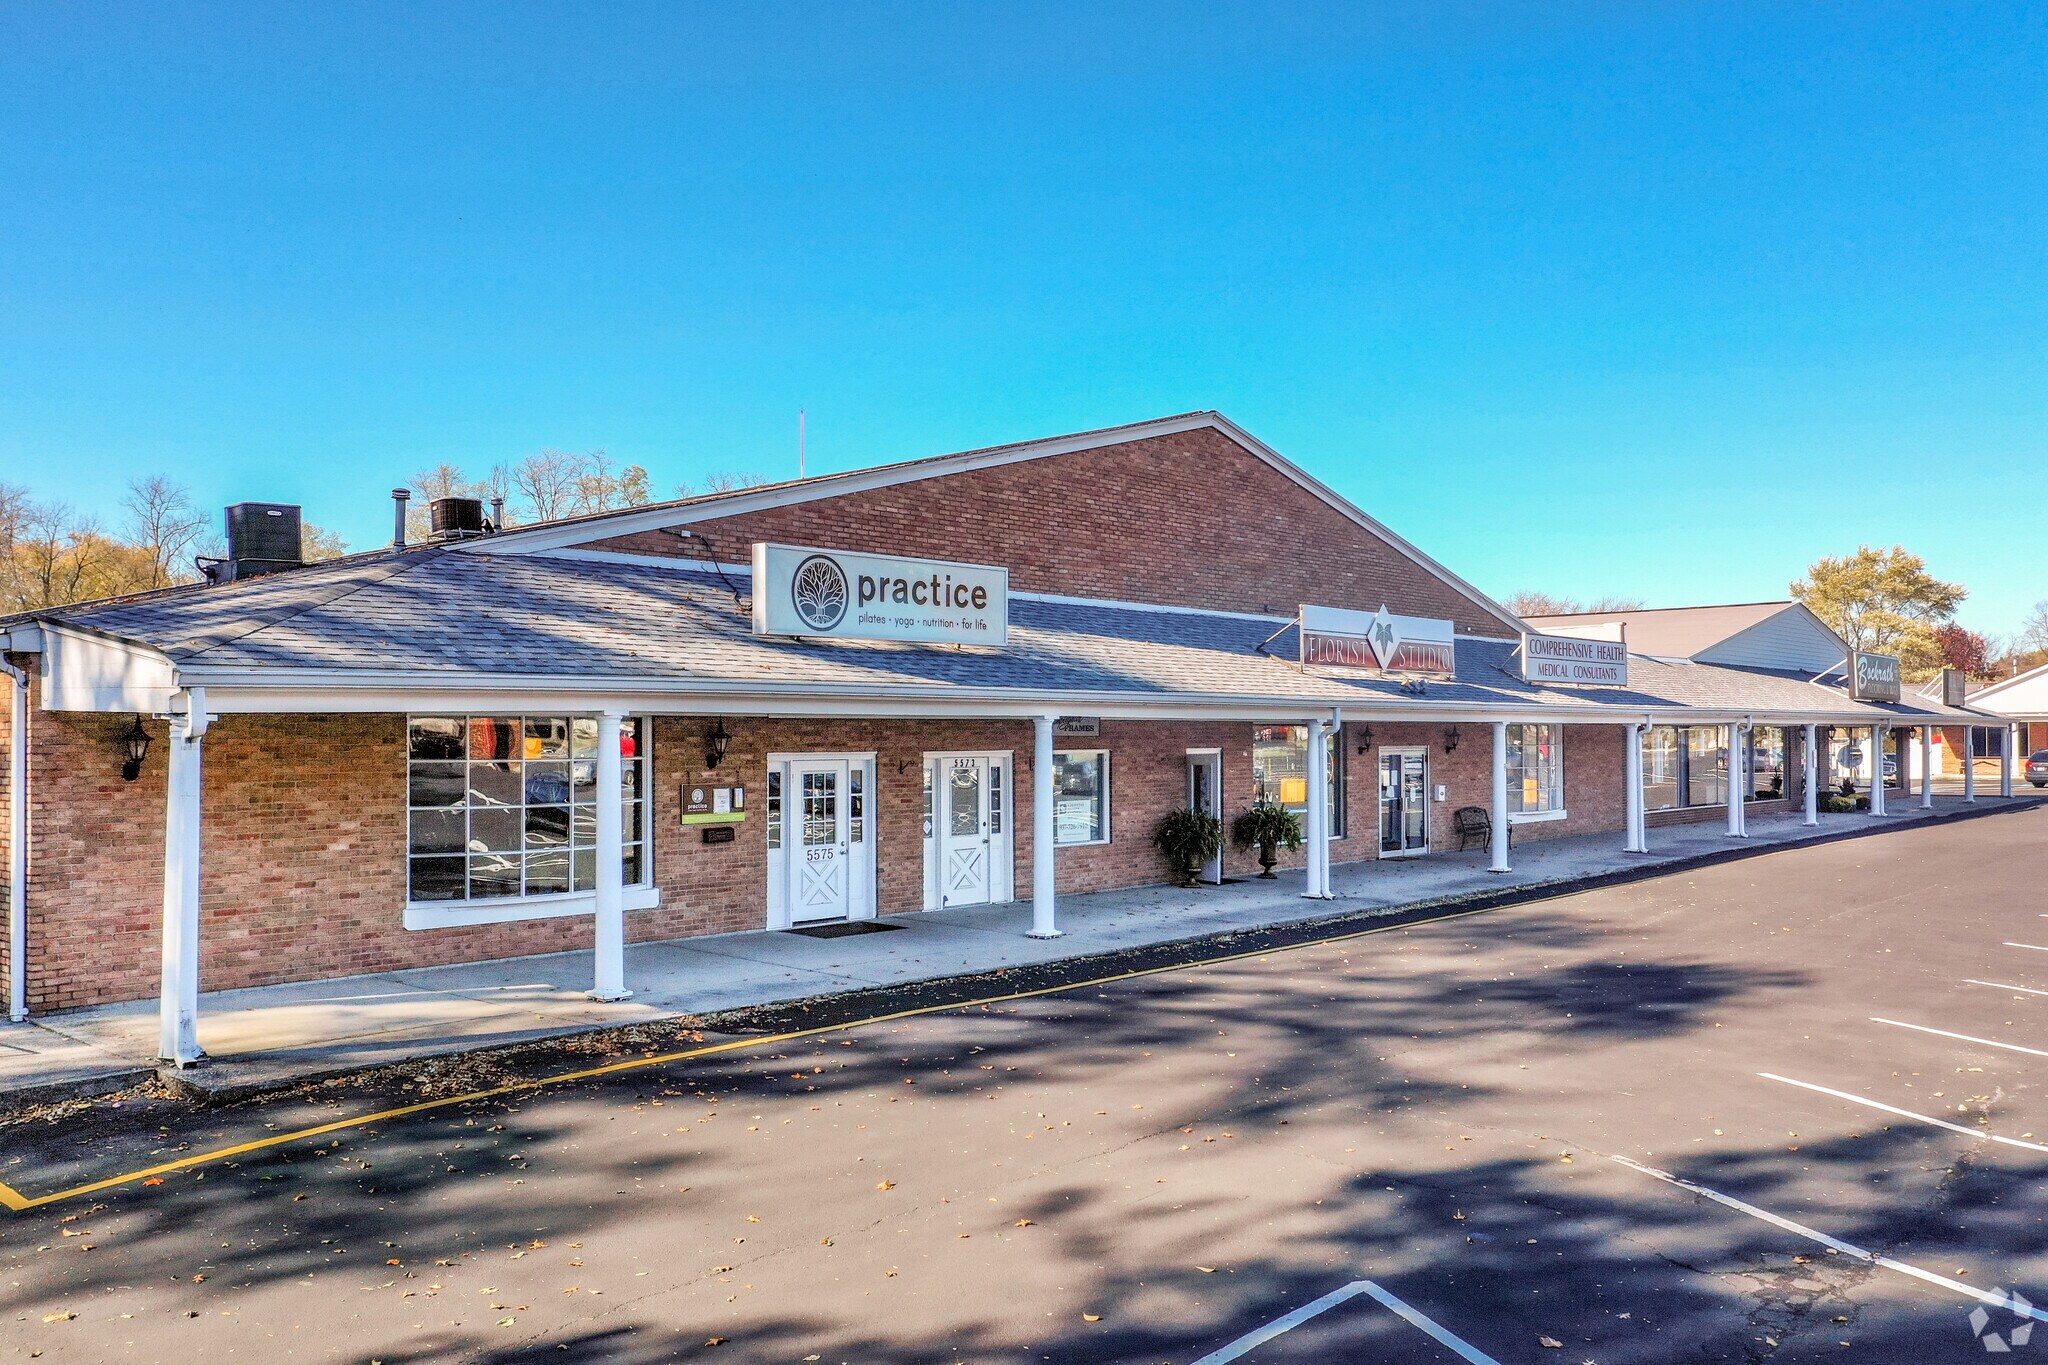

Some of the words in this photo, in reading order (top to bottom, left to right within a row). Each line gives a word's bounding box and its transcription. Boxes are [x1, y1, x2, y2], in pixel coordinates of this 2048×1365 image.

[858, 574, 987, 609] practice
[858, 612, 886, 625] pilates
[894, 617, 915, 629] yoga
[922, 617, 954, 628] nutrition
[961, 618, 973, 629] for
[975, 618, 987, 631] life
[1308, 637, 1367, 665] FLORIST
[1399, 645, 1450, 669] STUDIO
[1529, 638, 1593, 659] COMPREHENSIVE
[1597, 645, 1624, 660] HEALTH
[1537, 663, 1569, 677] MEDICAL
[1573, 665, 1618, 680] CONSULTANTS
[1857, 656, 1894, 690] Bockrath
[1064, 724, 1095, 732] FRAMES
[954, 758, 975, 768] 5573
[687, 803, 708, 811] practice
[806, 848, 834, 861] 5575
